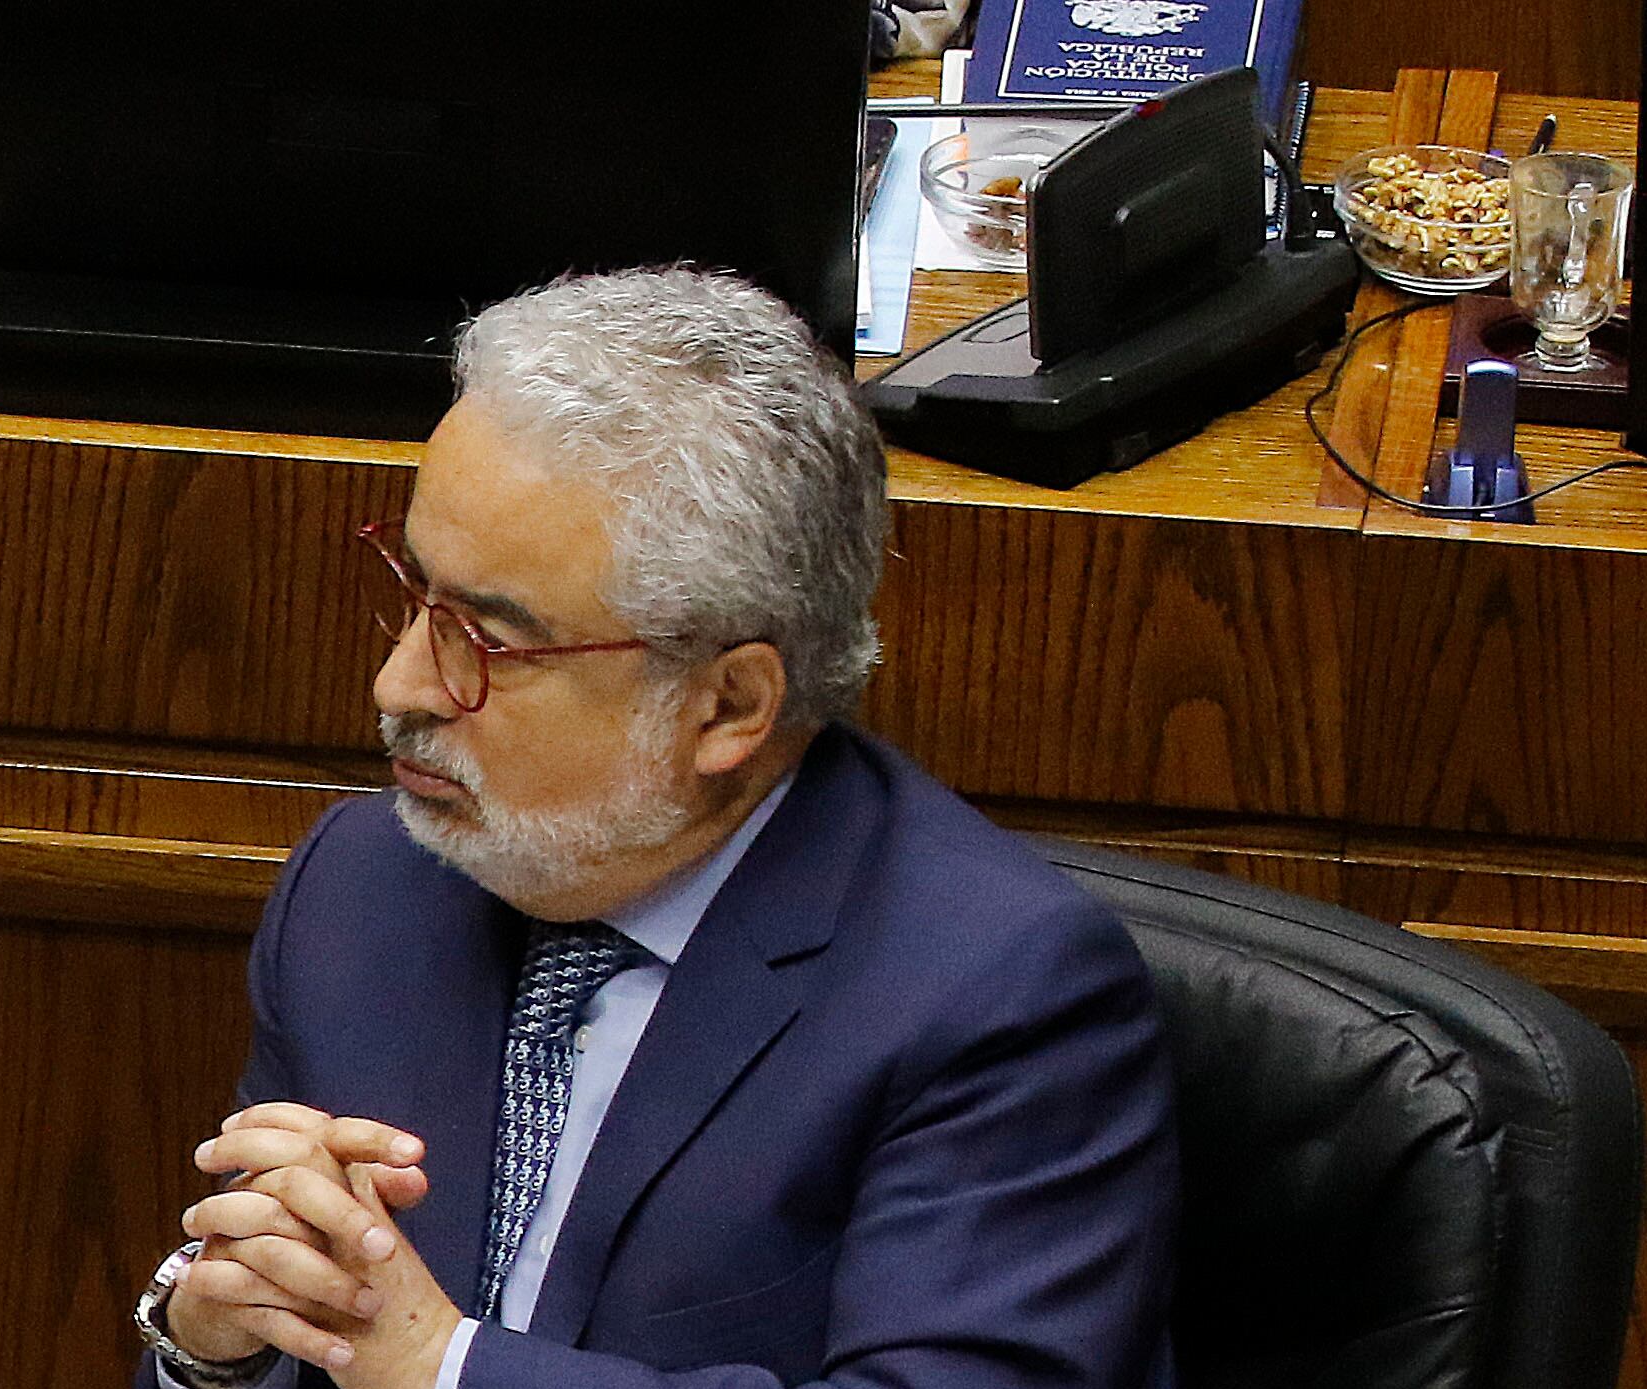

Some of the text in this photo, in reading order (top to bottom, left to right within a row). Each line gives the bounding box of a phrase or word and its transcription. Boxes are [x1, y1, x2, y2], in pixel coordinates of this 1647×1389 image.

[1058, 41, 1206, 58] REPUBLICA
[1092, 52, 1168, 64] DE LA
[1024, 66, 1206, 83] ONSTITUCIÓN
[1065, 59, 1189, 74] POLITICA
